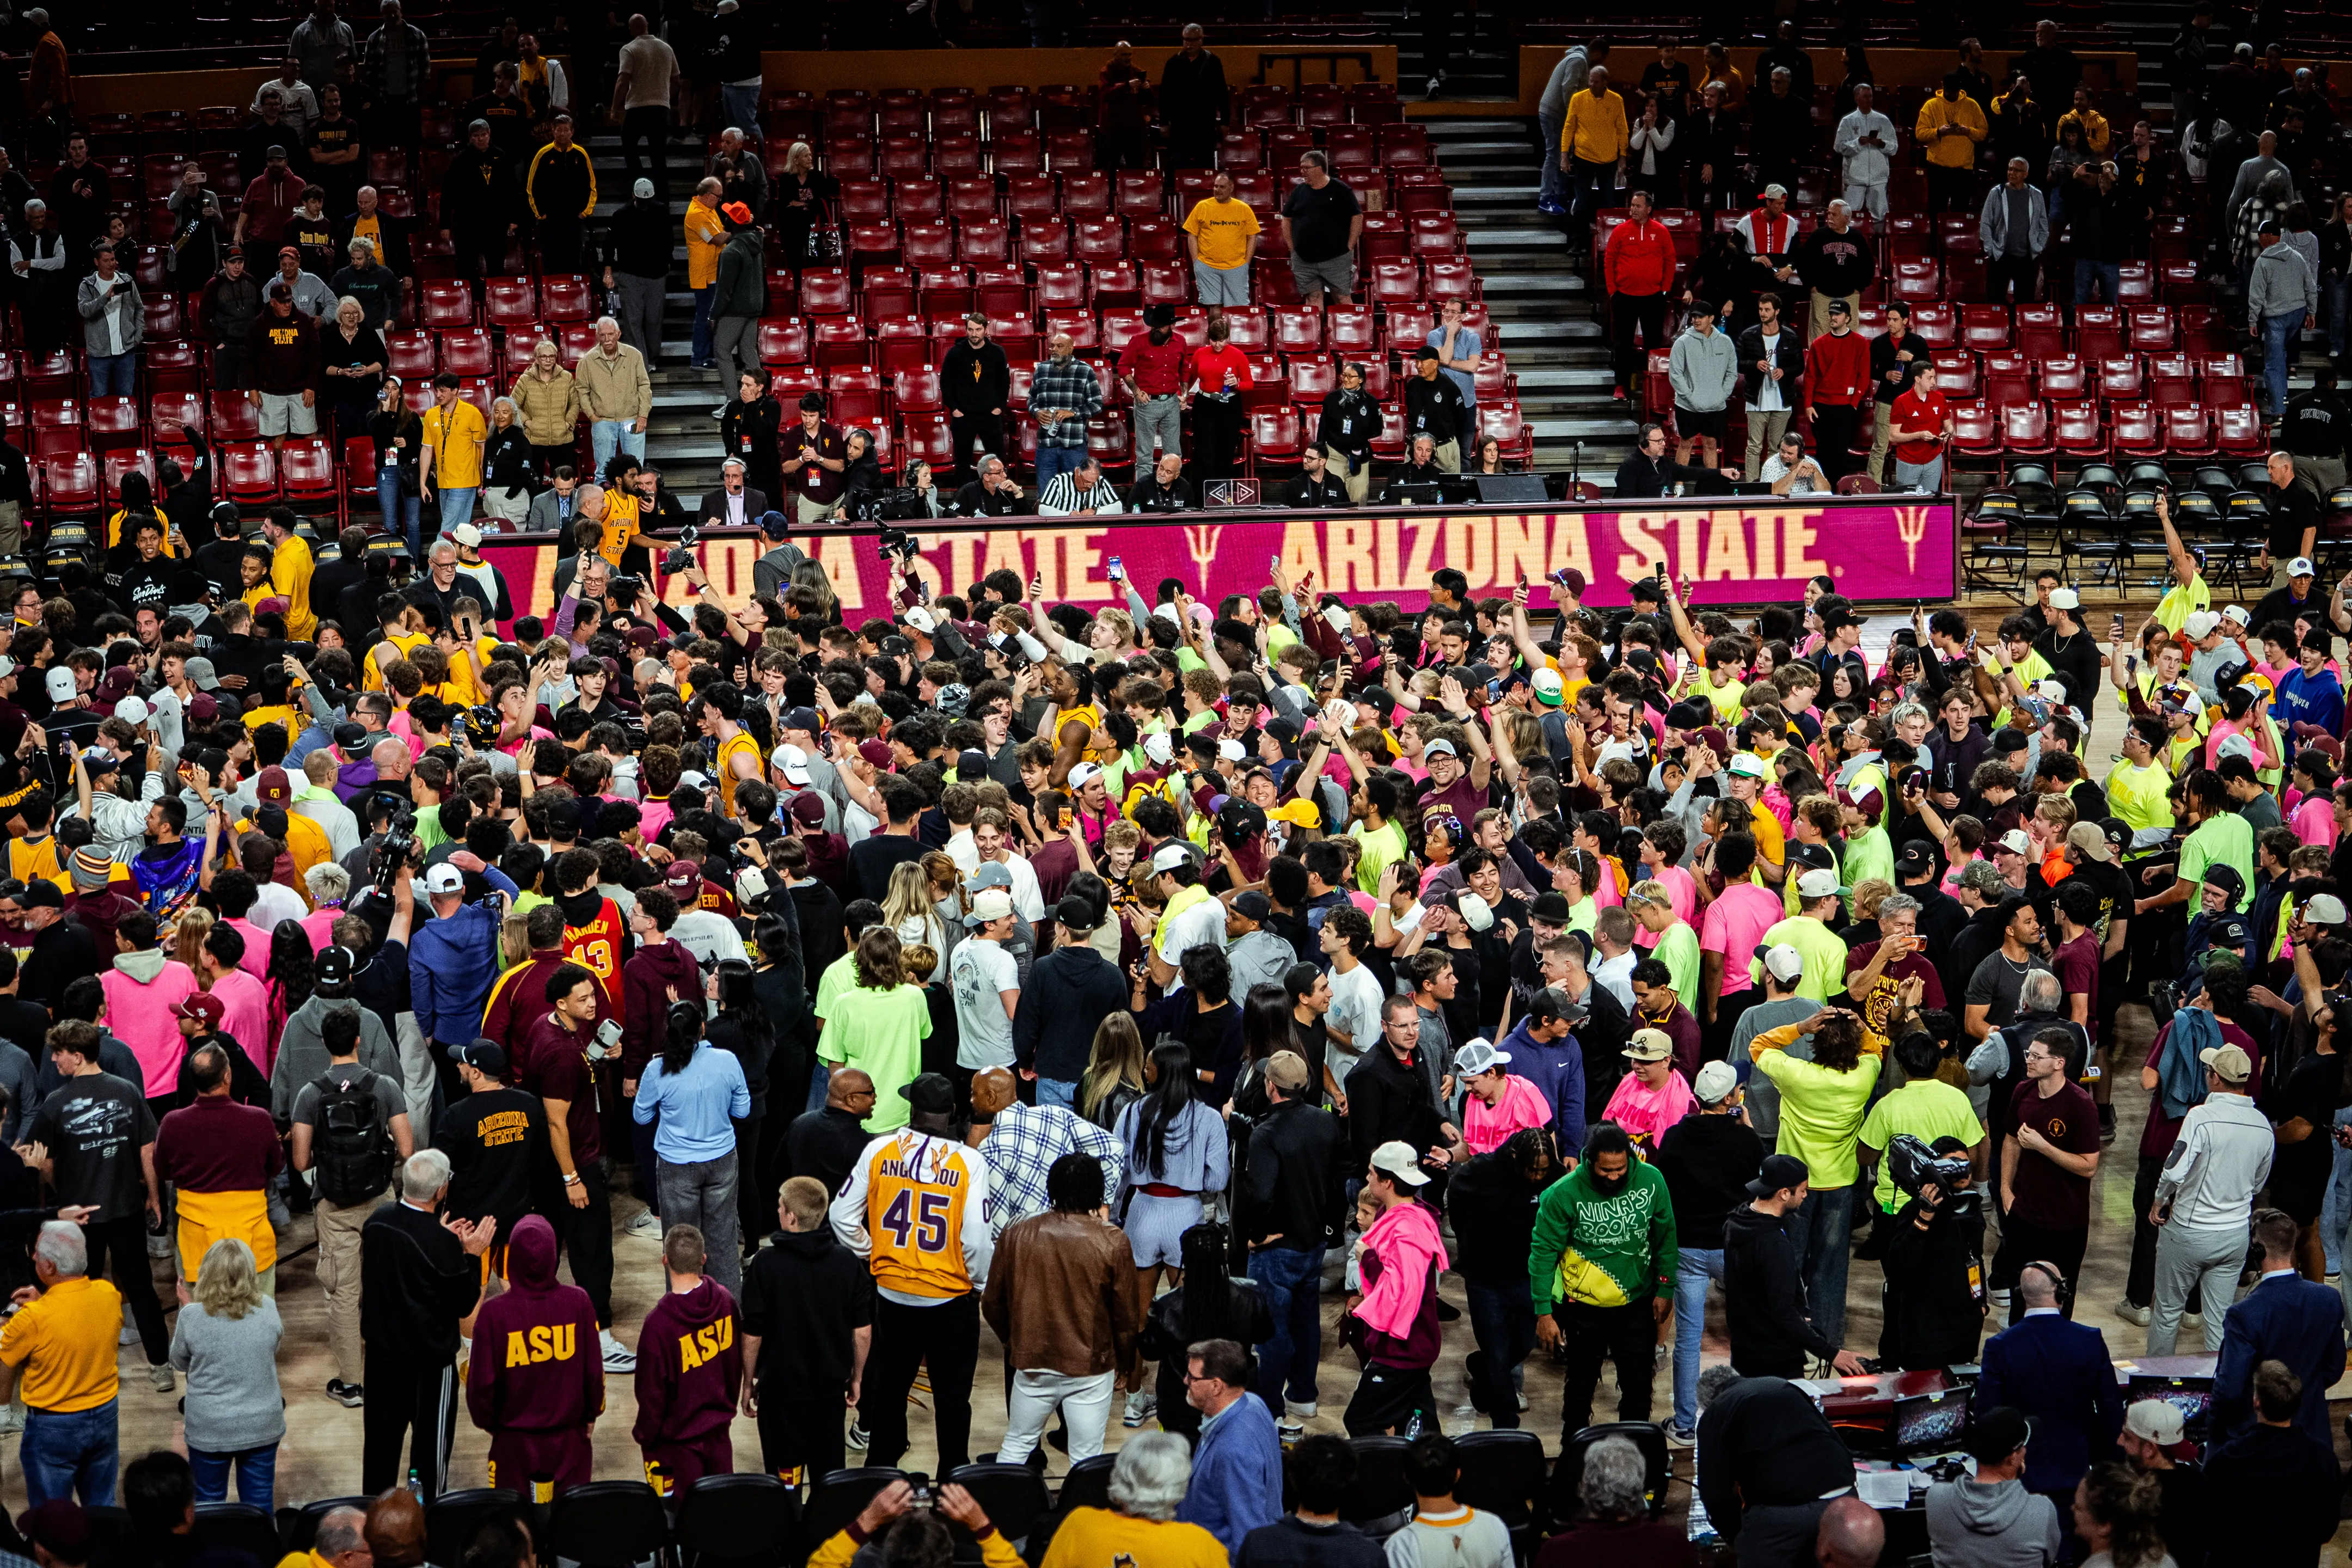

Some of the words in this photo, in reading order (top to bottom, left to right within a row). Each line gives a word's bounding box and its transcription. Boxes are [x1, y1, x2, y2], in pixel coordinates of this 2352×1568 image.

[300, 231, 313, 243] Sun
[2300, 408, 2331, 424] SECURITY
[610, 518, 633, 528] ARIZONA
[617, 530, 626, 546] 5
[887, 528, 1114, 602] STATE
[1278, 514, 1595, 593] ARIZONA
[492, 724, 500, 734] 18
[565, 919, 609, 943] HARDEN
[572, 939, 614, 979] 13
[965, 952, 980, 977] FISHING
[477, 1111, 529, 1138] ARIZONA
[485, 1126, 524, 1147] STATE
[1576, 1188, 1649, 1222] NINA'S
[881, 1188, 952, 1253] 45
[1579, 1214, 1638, 1240] BOOK
[1592, 1234, 1630, 1246] LITTLE
[506, 1323, 576, 1368] ASU
[678, 1315, 734, 1374] ASU
